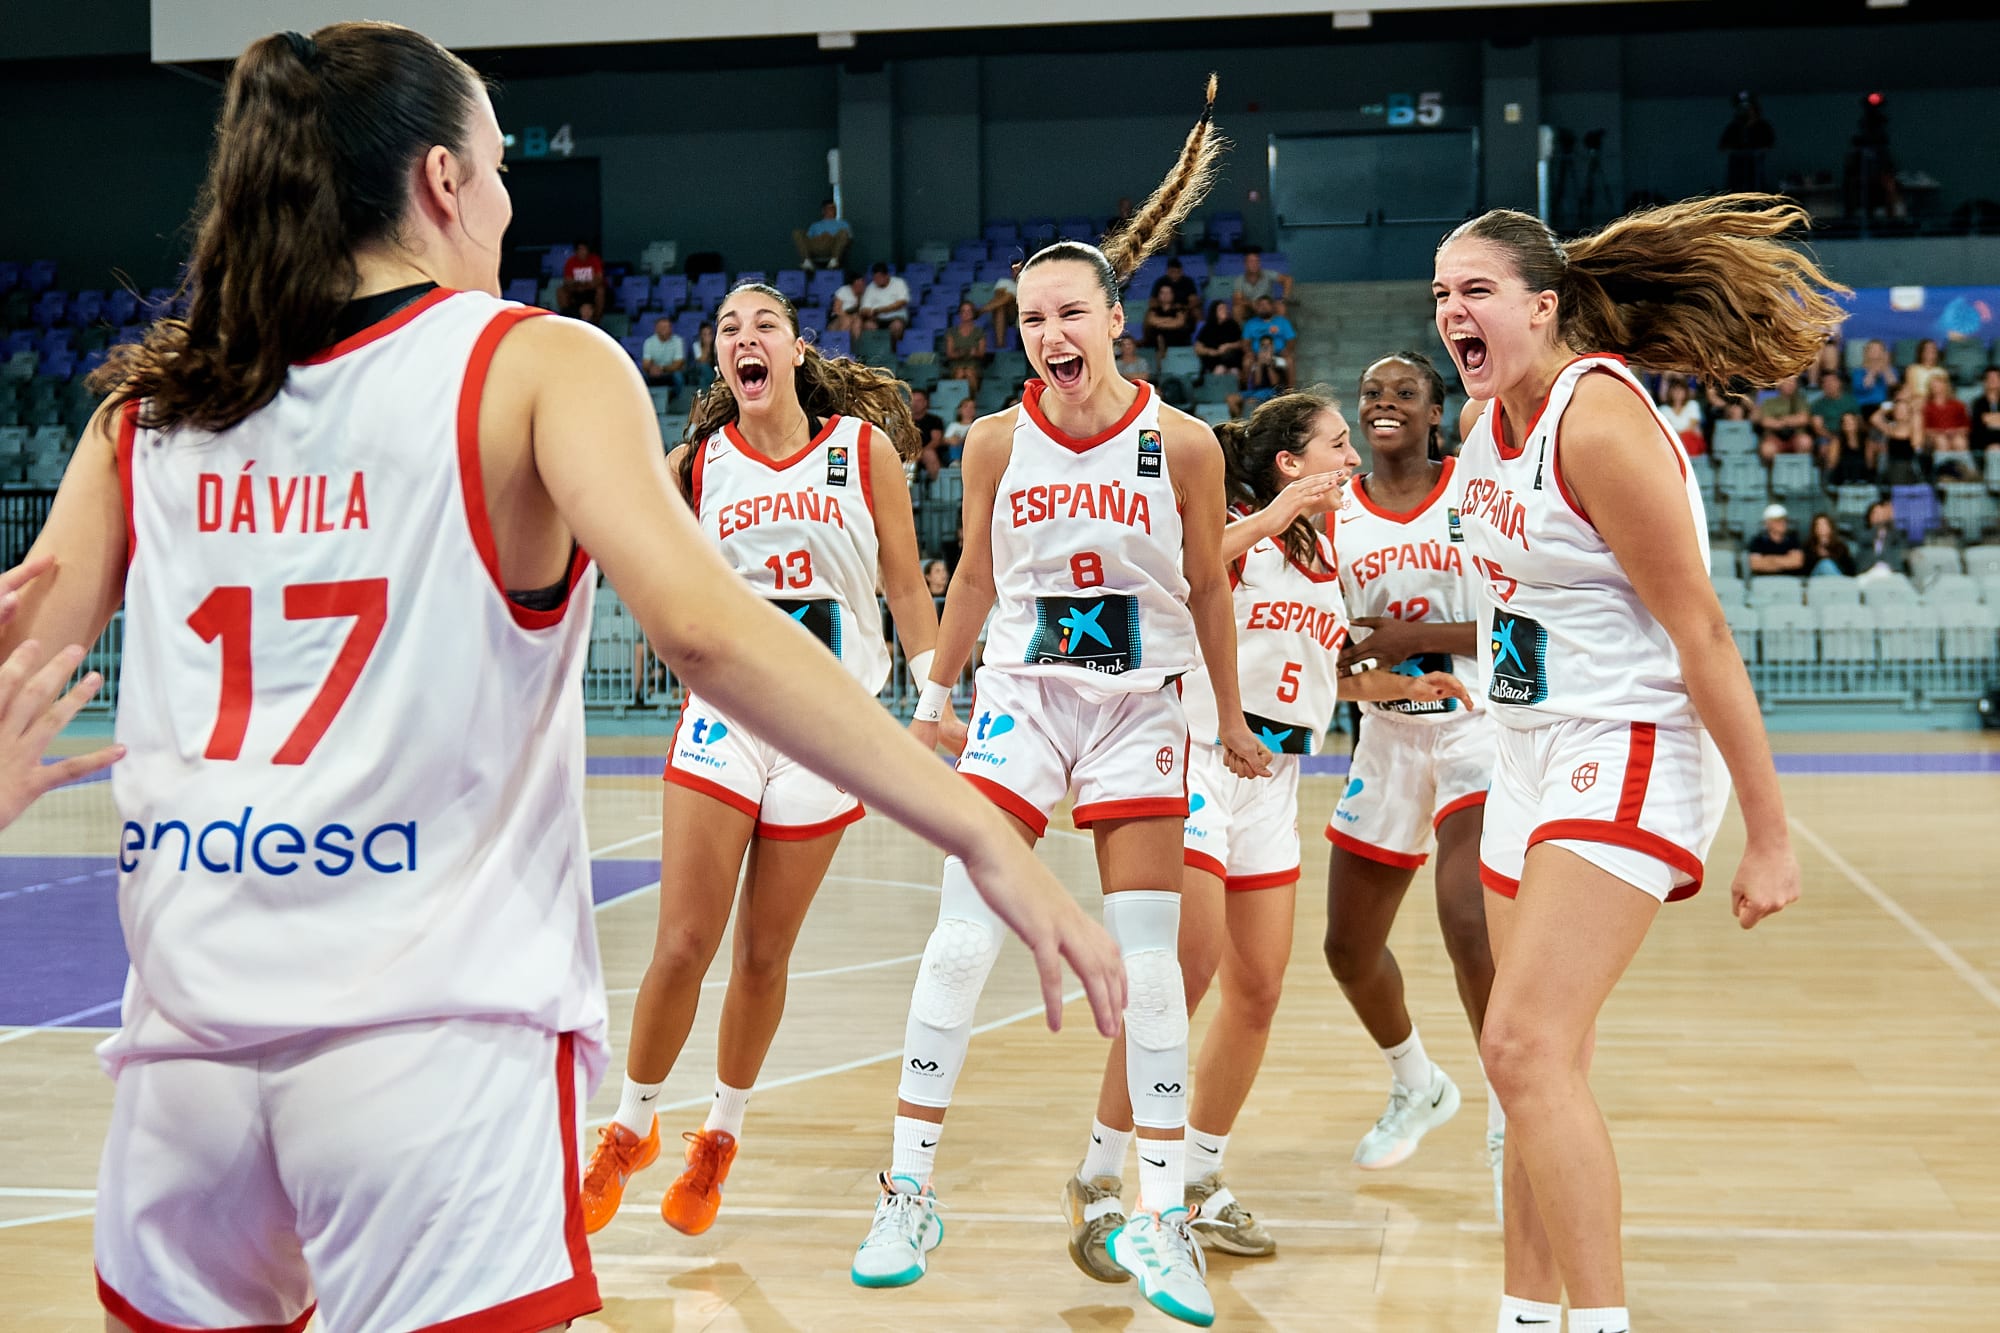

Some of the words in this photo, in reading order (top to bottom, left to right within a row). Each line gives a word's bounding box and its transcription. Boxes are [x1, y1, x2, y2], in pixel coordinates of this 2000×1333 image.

[1388, 92, 1442, 125] B5
[524, 125, 573, 157] B4
[1141, 456, 1158, 465] FIBA
[198, 460, 369, 534] DÁVILA
[719, 486, 844, 540] ESPAÑA
[1009, 480, 1151, 535] ESPAÑA
[1461, 478, 1529, 551] ESPAÑA
[765, 549, 813, 590] 13
[1070, 552, 1104, 588] 8
[1351, 539, 1462, 589] ESPAÑA
[1246, 601, 1348, 651] ESPAÑA
[1387, 596, 1430, 622] 12
[187, 577, 389, 766] 17
[1276, 661, 1302, 704] 5
[679, 749, 727, 769] tenerife!
[119, 805, 418, 877] endesa
